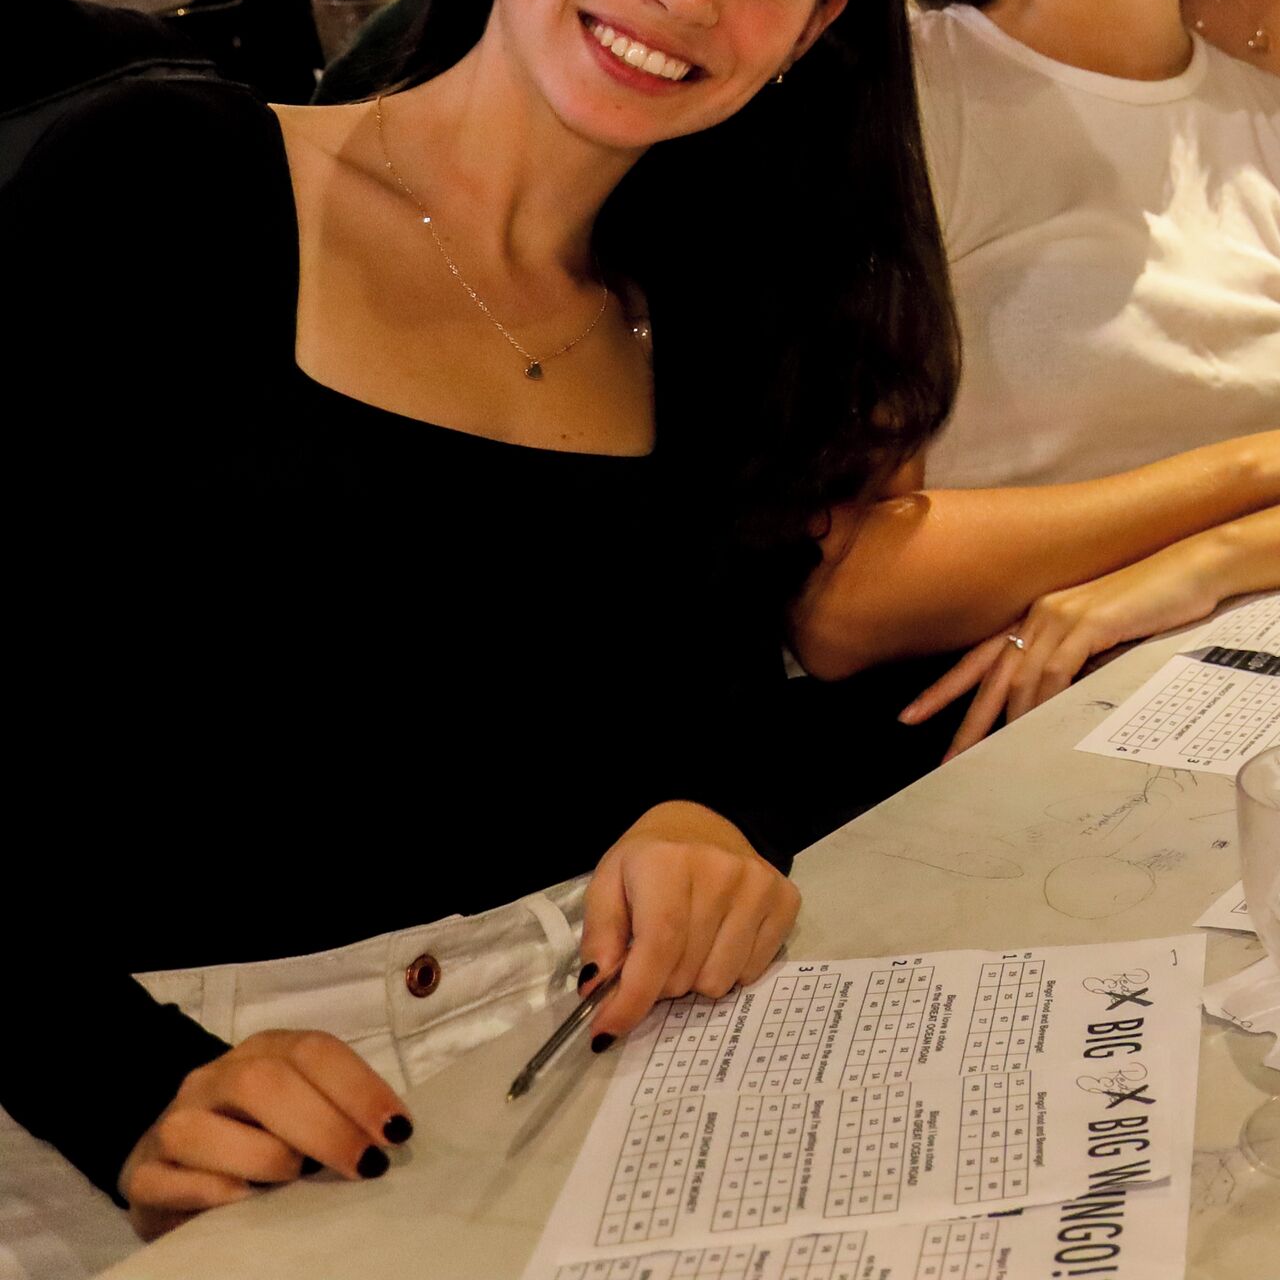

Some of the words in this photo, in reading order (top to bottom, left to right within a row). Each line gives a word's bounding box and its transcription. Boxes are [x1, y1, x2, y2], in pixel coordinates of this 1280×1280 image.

[1043, 980, 1055, 996] Bingo!
[739, 994, 753, 1013] BINGO!
[928, 1002, 940, 1021] GREAT
[1042, 998, 1052, 1011] Food
[732, 1015, 746, 1033] SHOW
[922, 1022, 935, 1043] OCEAN
[1034, 1024, 1047, 1052] Beverage!
[1084, 1018, 1144, 1058] BIG
[918, 1044, 929, 1063] ROAD!
[714, 1058, 730, 1082] MONEY!
[1088, 1116, 1150, 1157] BIG
